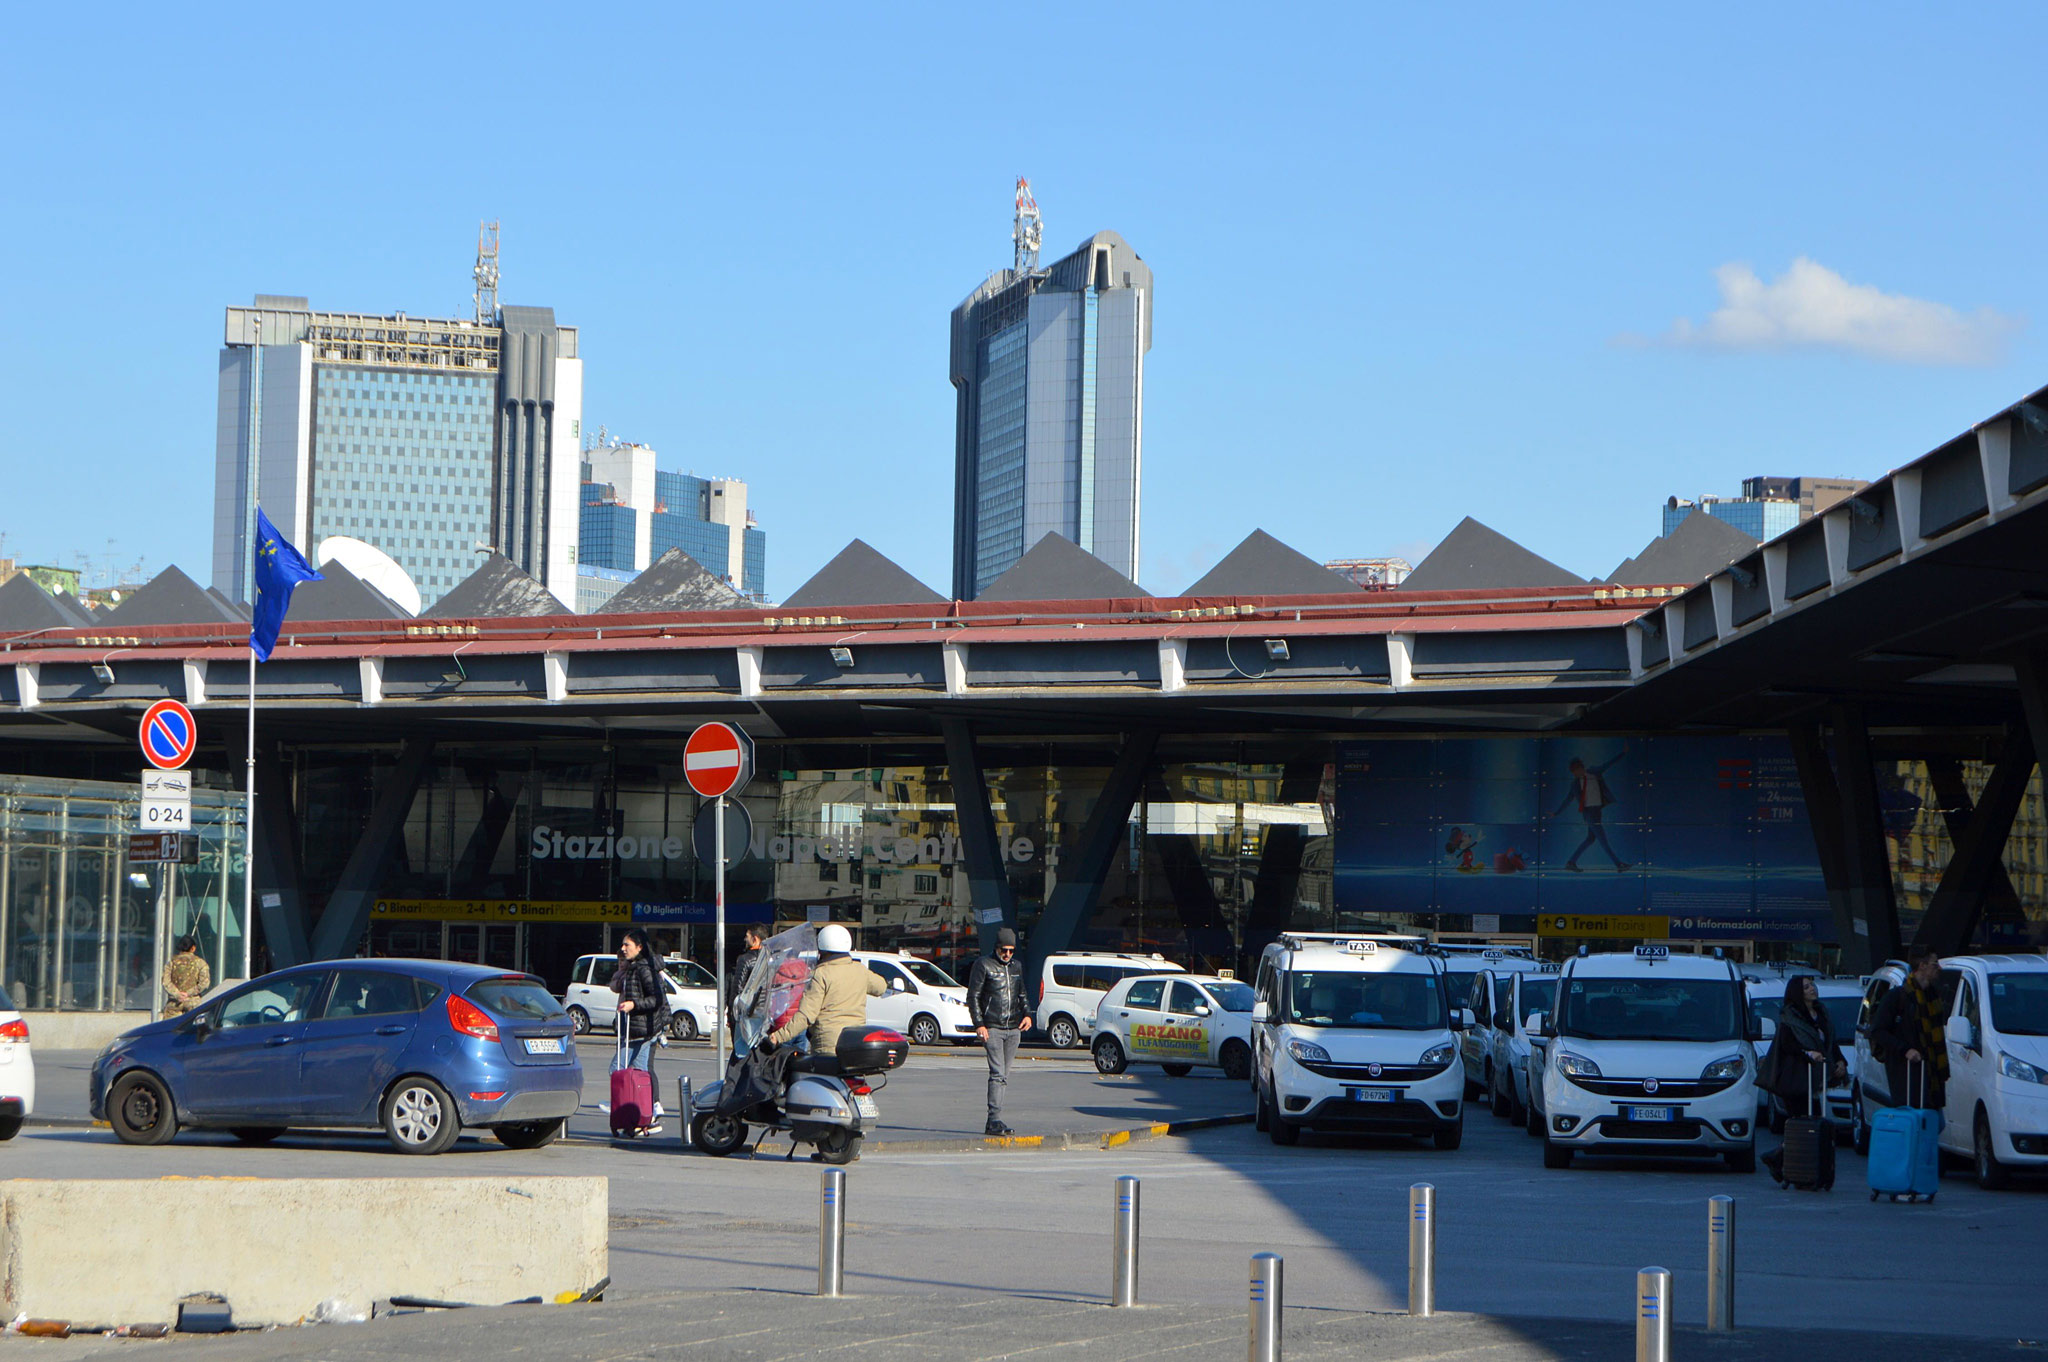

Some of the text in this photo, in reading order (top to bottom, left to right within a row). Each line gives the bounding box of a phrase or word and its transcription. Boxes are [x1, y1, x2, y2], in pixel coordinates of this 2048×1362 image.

[149, 807, 183, 822] 0-24
[1772, 808, 1793, 818] TIM
[532, 825, 683, 859] Stazione
[390, 902, 422, 914] Binari
[466, 903, 486, 914] 2-4
[521, 904, 627, 916] Binari Platforms 5-24
[652, 905, 683, 916] Biglietti
[1571, 918, 1646, 931] Treni Trains
[1697, 918, 1763, 929] Informazioni
[1350, 943, 1375, 951] TAXI
[1639, 946, 1664, 955] TAXI
[1485, 951, 1503, 959] TAXI
[1136, 1024, 1203, 1041] ARZANO
